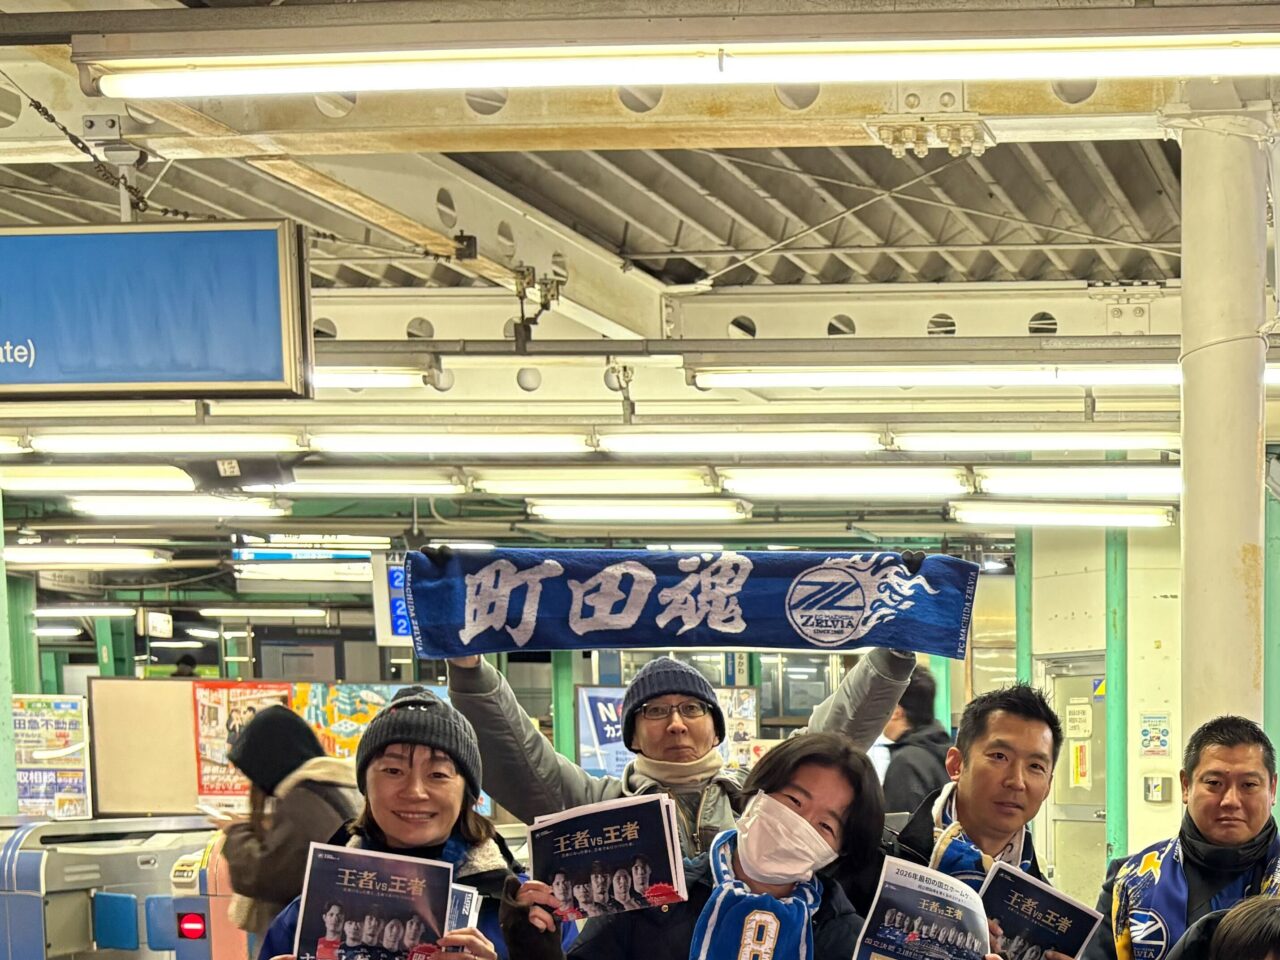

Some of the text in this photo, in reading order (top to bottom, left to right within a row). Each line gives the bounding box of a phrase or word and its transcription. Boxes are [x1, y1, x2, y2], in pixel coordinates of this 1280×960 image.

[459, 552, 754, 648] 町田魂
[959, 599, 972, 641] MACHIDA
[800, 615, 855, 629] ZELVIA
